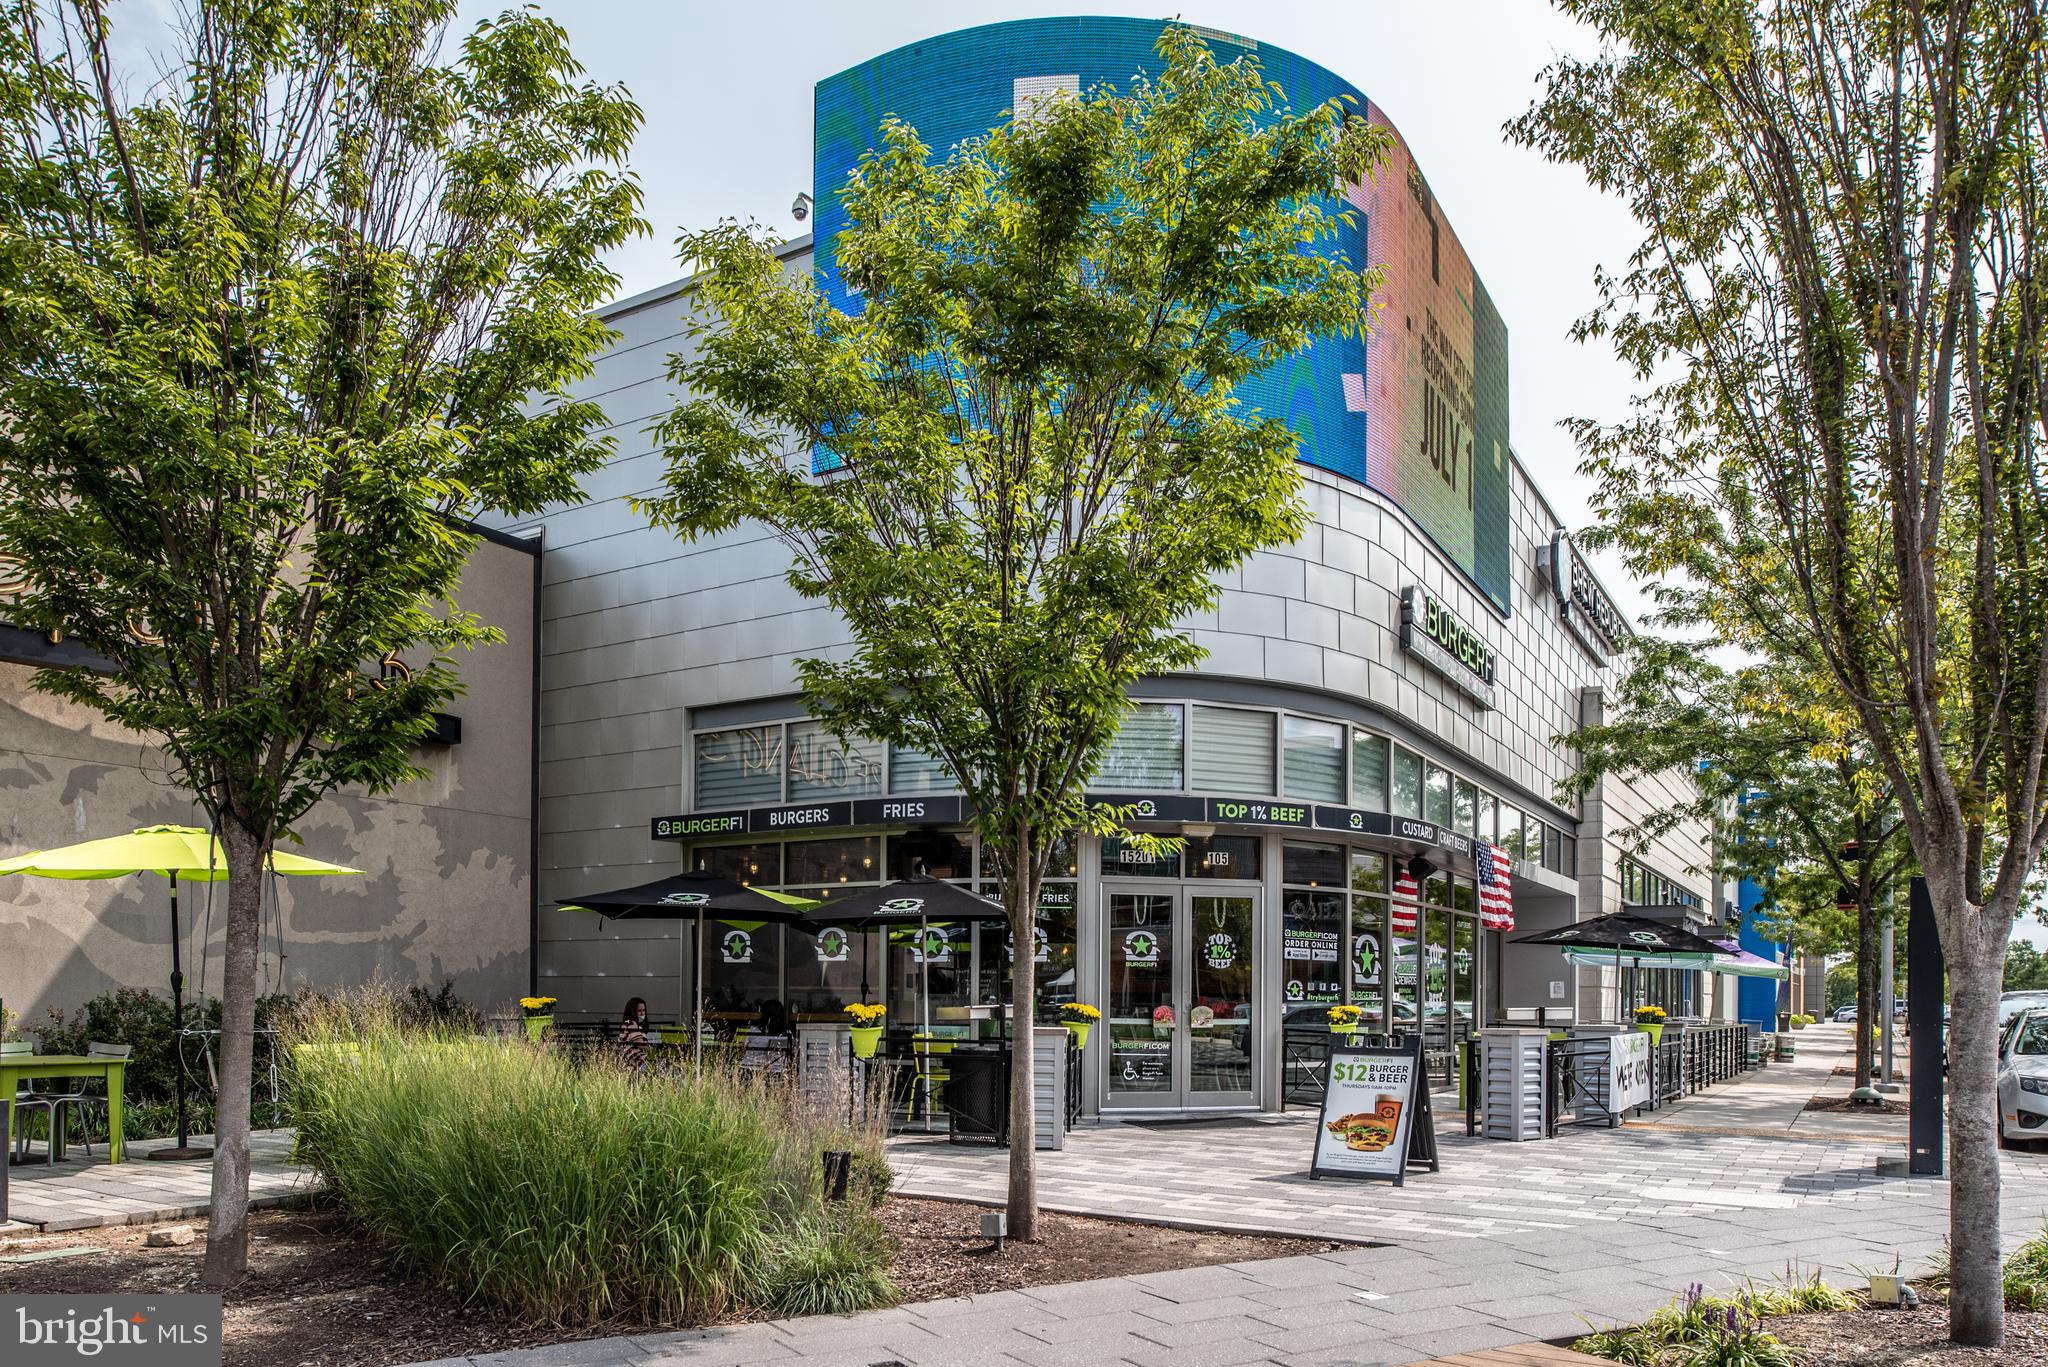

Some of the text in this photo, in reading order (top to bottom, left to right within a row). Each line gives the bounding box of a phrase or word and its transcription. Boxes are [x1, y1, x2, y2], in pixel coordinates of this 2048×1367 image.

[1420, 377, 1473, 512] JULY 1
[770, 808, 829, 826] BURGERS
[883, 803, 925, 818] FRIES
[1216, 803, 1305, 822] TOP 1% BEEF
[672, 816, 743, 835] BURGERFI
[1402, 821, 1434, 840] CUSTARD
[1439, 831, 1468, 853] CRAFT BEERS
[1208, 853, 1228, 865] 105
[1042, 894, 1069, 903] FRIES
[1209, 933, 1233, 945] TOP
[1285, 940, 1338, 950] ORDER ONLINE
[1210, 944, 1232, 959] 1%
[1208, 958, 1232, 969] BEEF
[1112, 1042, 1170, 1050] BURGERFI.COM
[1333, 1062, 1409, 1083] $12 BURGER
[1368, 1073, 1408, 1083] & BEER
